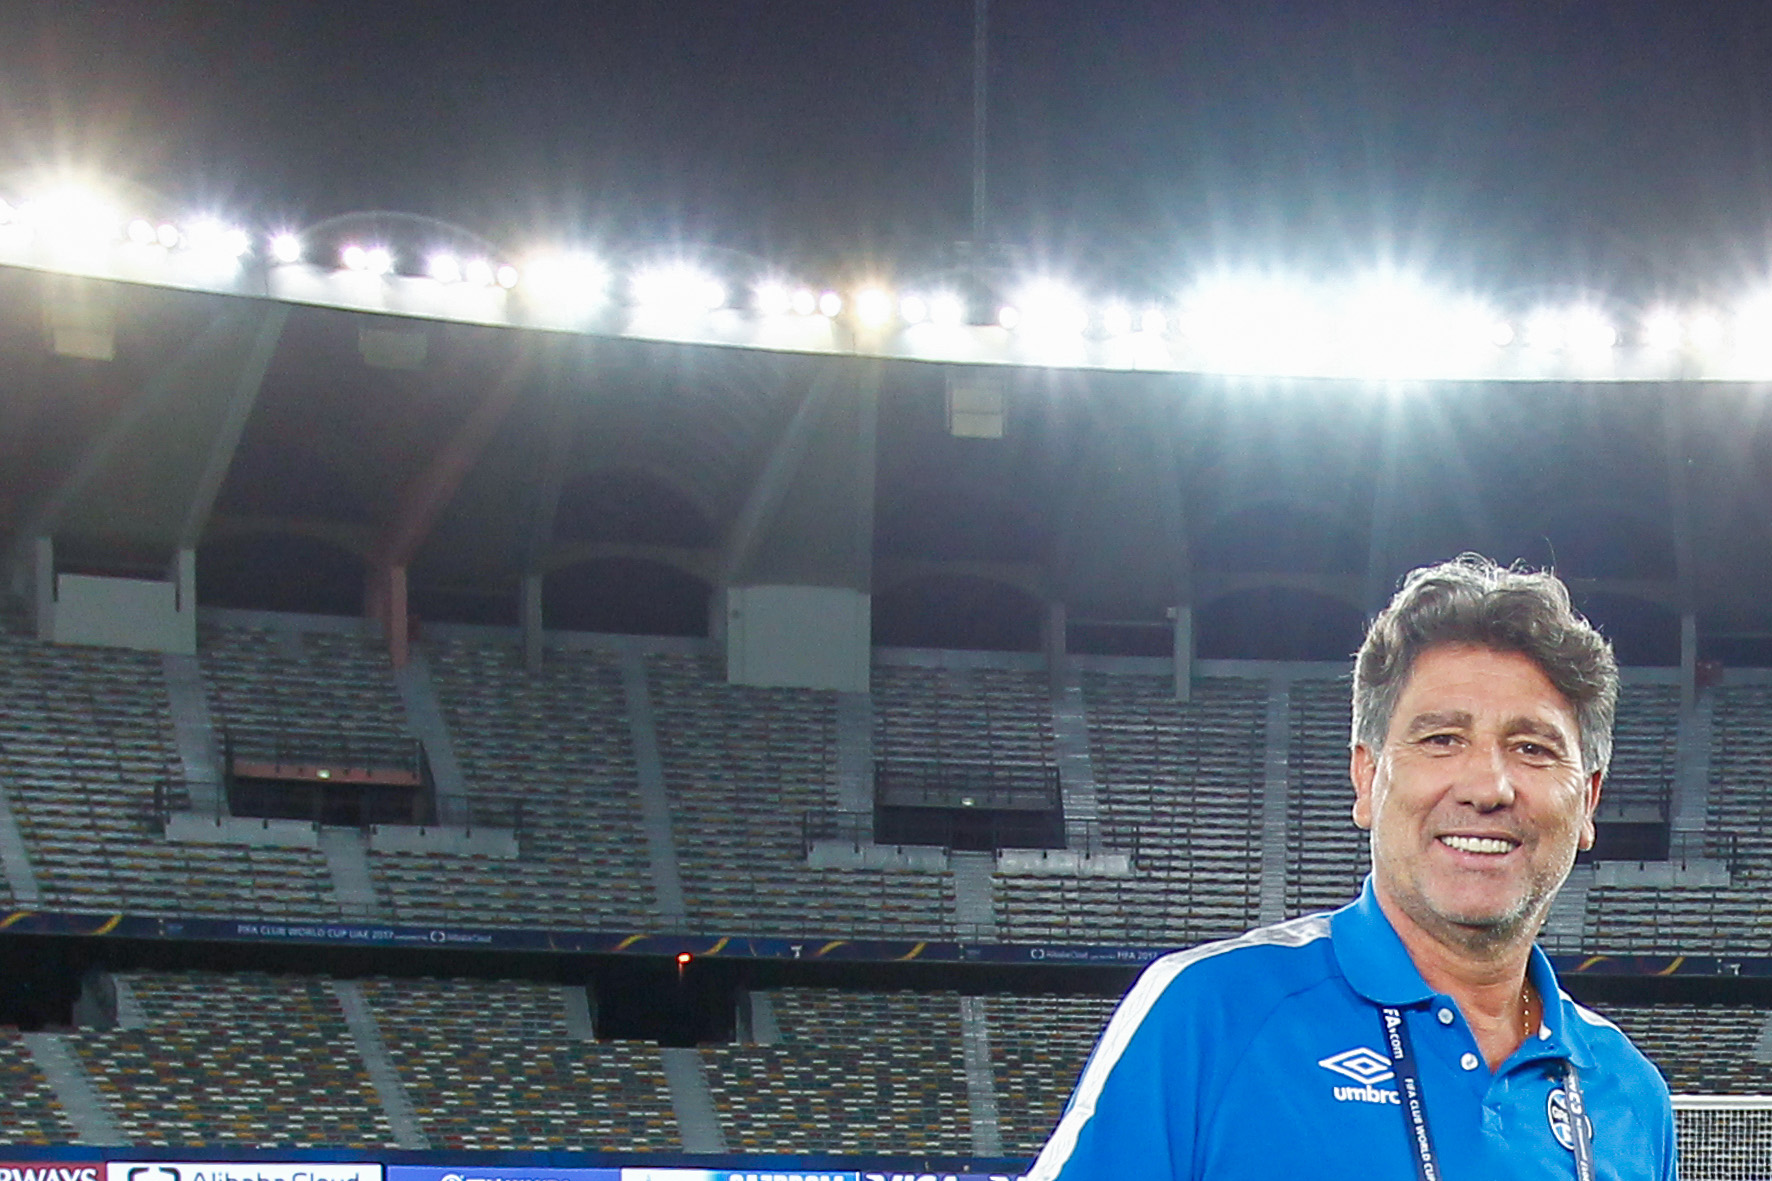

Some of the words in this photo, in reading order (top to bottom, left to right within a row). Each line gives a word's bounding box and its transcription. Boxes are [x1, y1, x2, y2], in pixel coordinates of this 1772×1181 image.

[327, 928, 348, 938] CUP
[1404, 1077, 1417, 1099] FIFA
[1409, 1099, 1424, 1125] CLUB
[1415, 1125, 1431, 1161] WORLD
